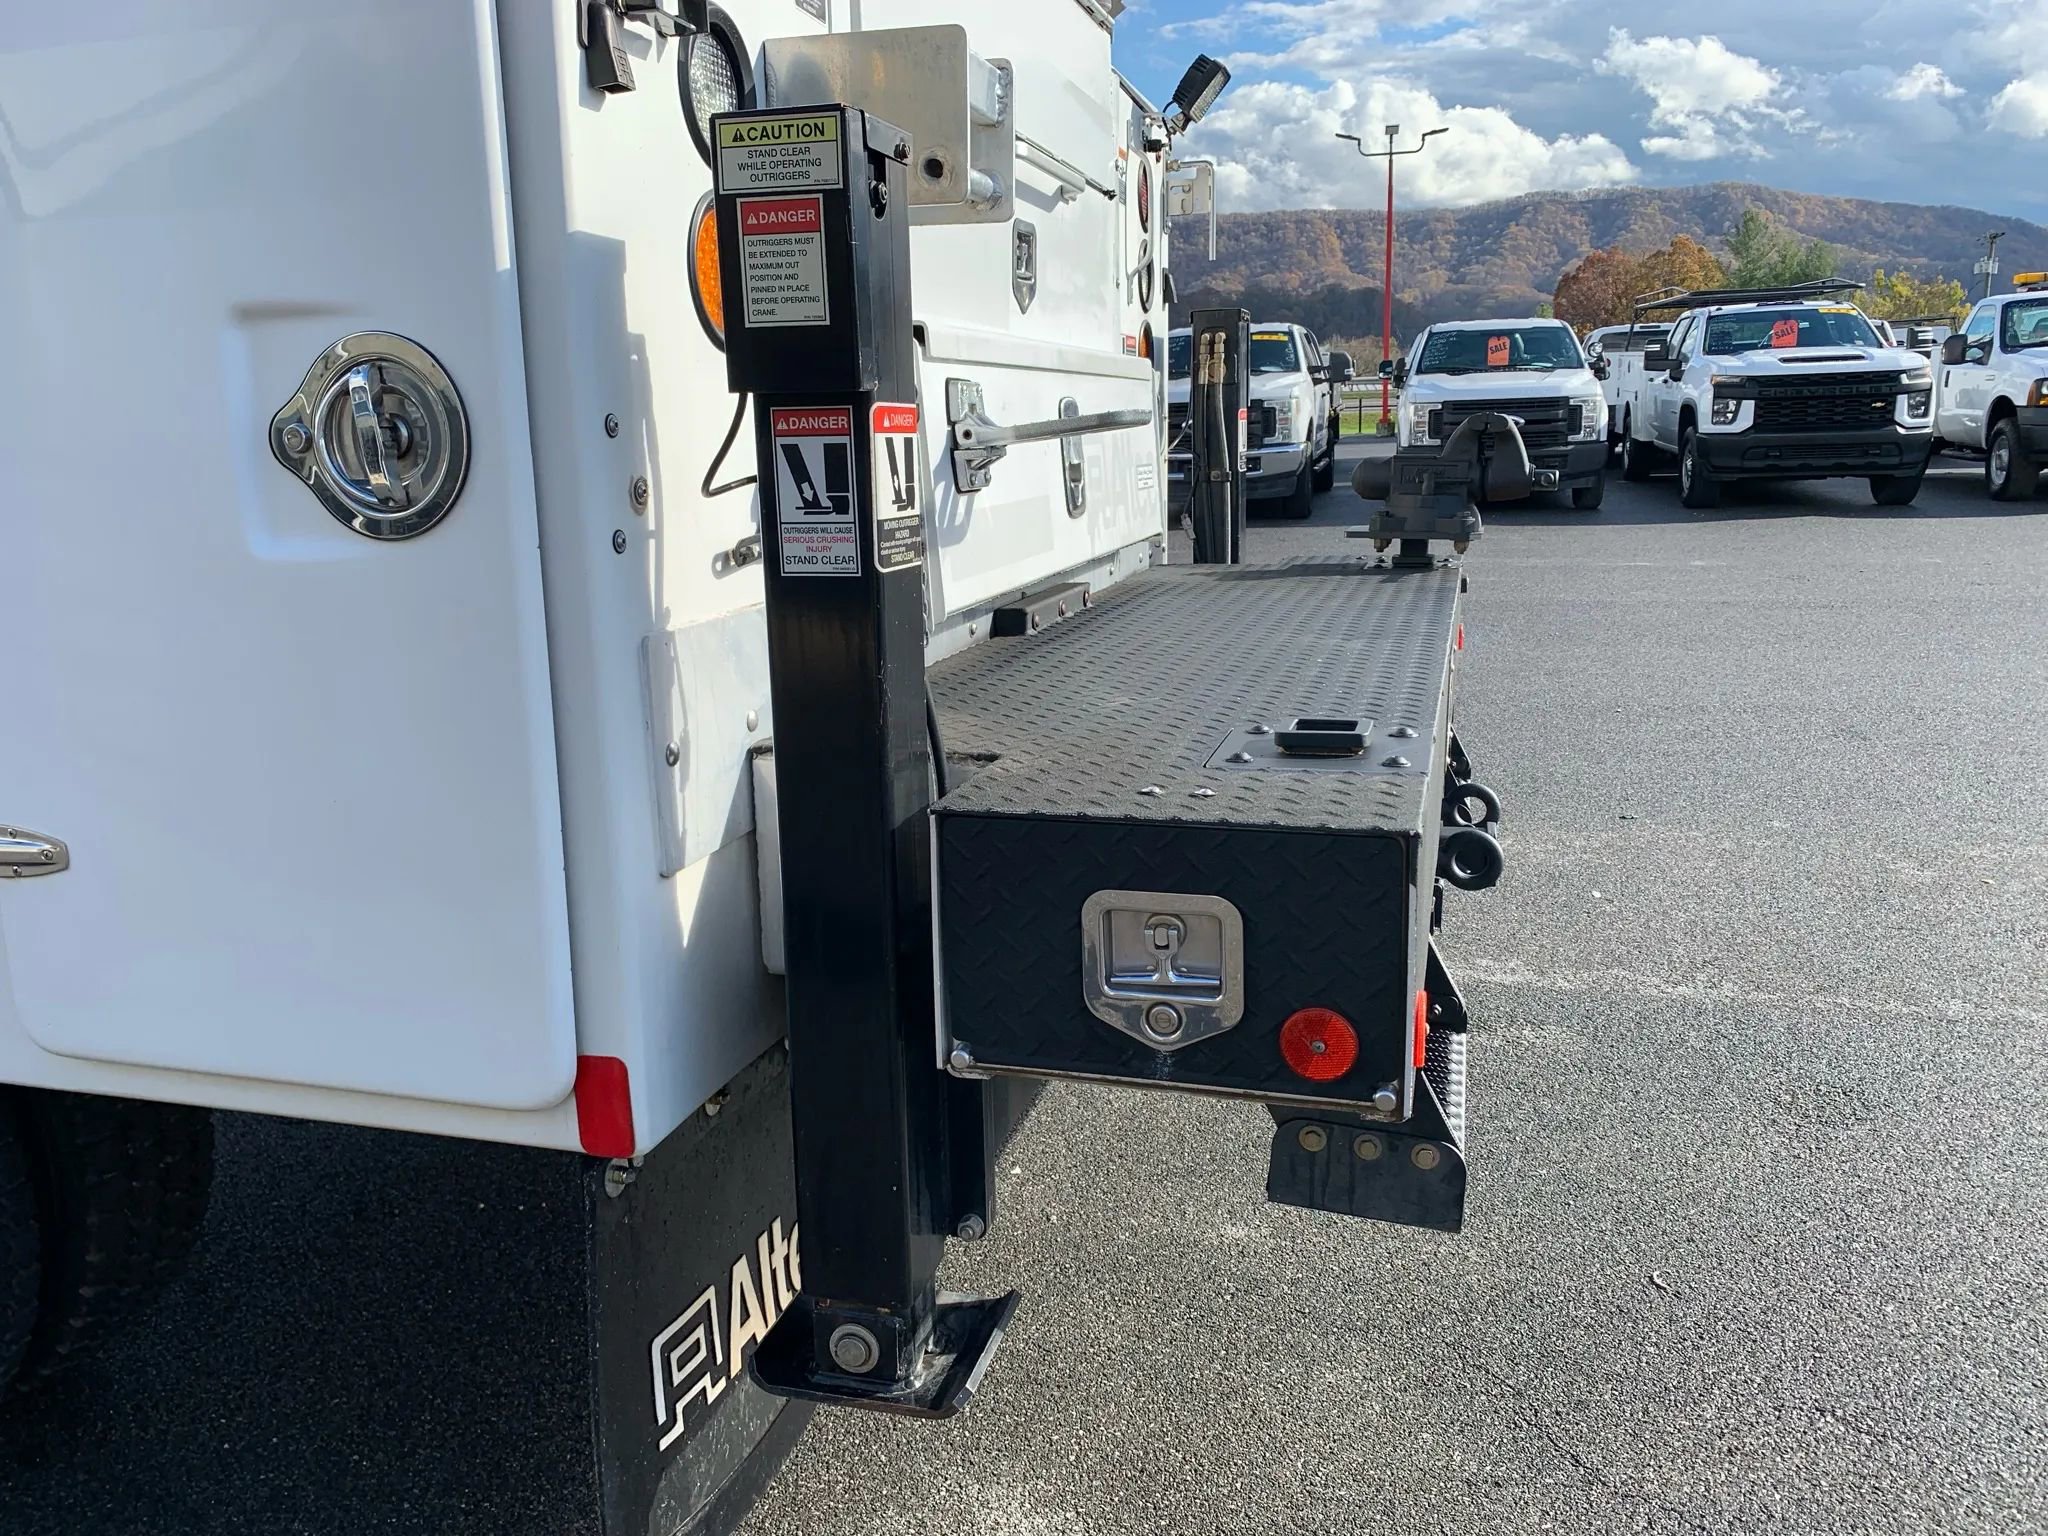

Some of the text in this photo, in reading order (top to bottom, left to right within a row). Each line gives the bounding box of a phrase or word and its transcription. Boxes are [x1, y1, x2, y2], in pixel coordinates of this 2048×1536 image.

[746, 122, 825, 141] CAUTION
[747, 146, 811, 159] STAND CLEAR
[737, 158, 822, 171] WHILE OPERATING
[750, 170, 811, 182] OUTRIGGERS
[759, 209, 816, 224] DANGER
[747, 237, 815, 247] OUTRIGGERS MUST
[748, 249, 808, 259] BE EXTENDED TO
[749, 261, 800, 270] MAXIMUM OUT
[750, 274, 782, 282] POSITION
[751, 285, 777, 293] PINNED
[786, 284, 810, 292] PLACE
[751, 296, 820, 305] BEFORE OPERATING
[752, 308, 778, 316] CRANE.
[1774, 325, 1796, 340] SALE
[1489, 341, 1508, 354] SALE
[1757, 384, 1898, 398] CHEVROLET
[789, 416, 848, 429] DANGER
[890, 413, 914, 426] DANGER
[783, 526, 853, 534] OUTRIGGERS WILL CAUSE
[783, 536, 855, 544] SERIOUS CRUSHING
[806, 545, 832, 553] INJURY
[785, 555, 855, 565] STAND CLEAR
